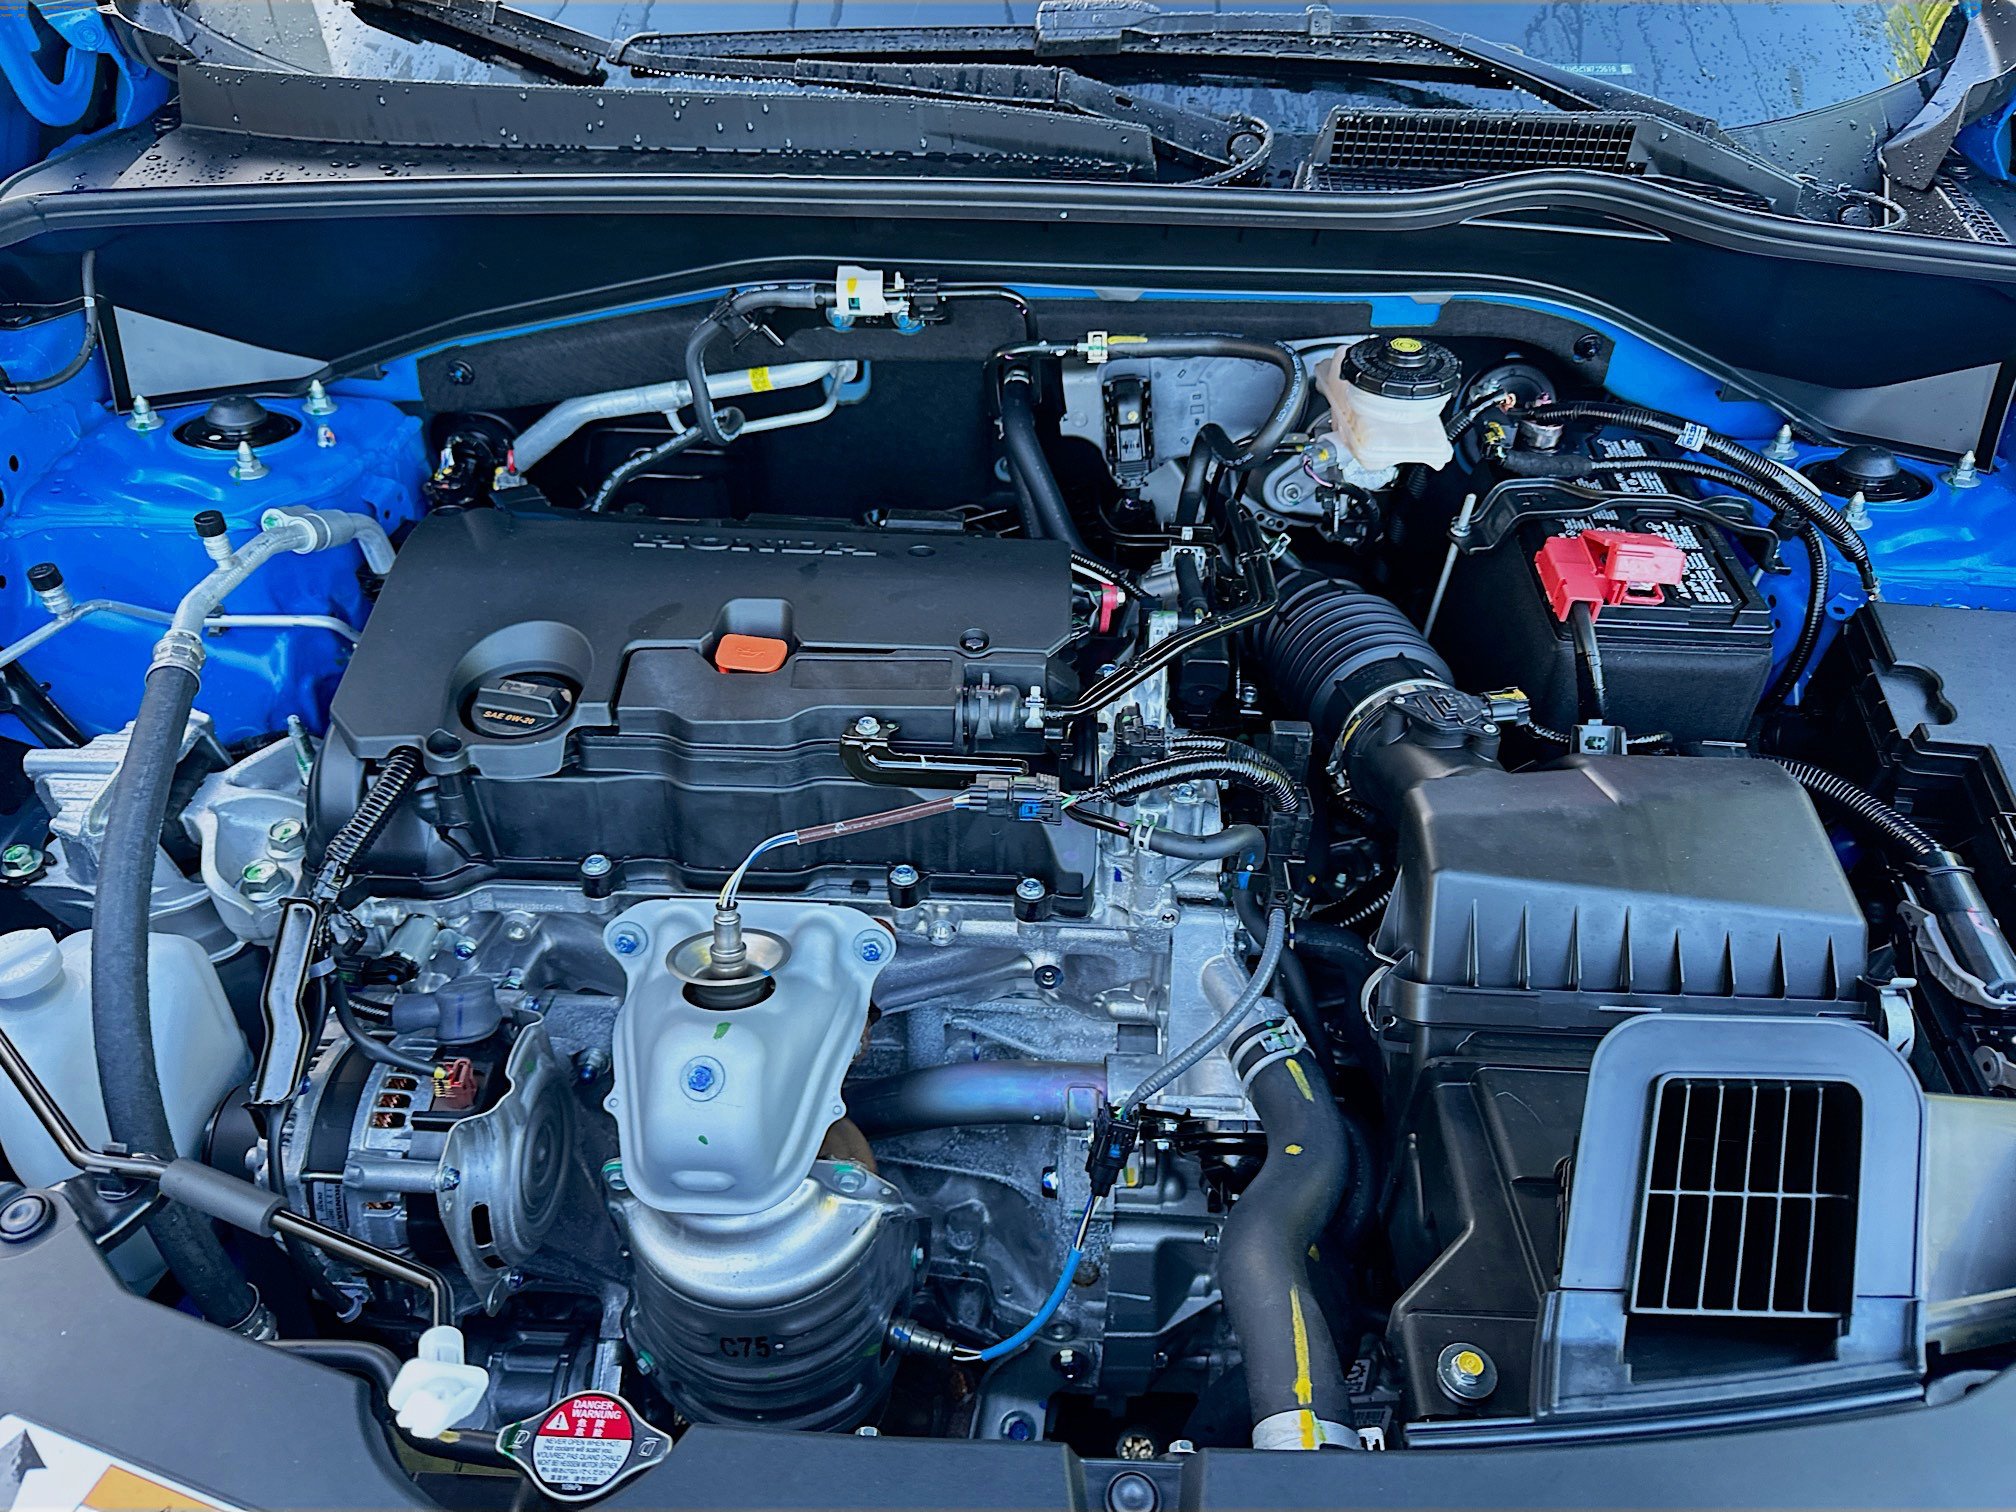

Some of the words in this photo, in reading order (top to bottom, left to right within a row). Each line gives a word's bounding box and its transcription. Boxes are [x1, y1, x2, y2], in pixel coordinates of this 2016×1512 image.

[632, 532, 878, 557] HONDA
[483, 710, 505, 720] SAE
[505, 713, 536, 725] 0W-20
[719, 1335, 771, 1358] C75
[573, 1400, 615, 1410] DANGER
[572, 1409, 622, 1419] WARNUNG
